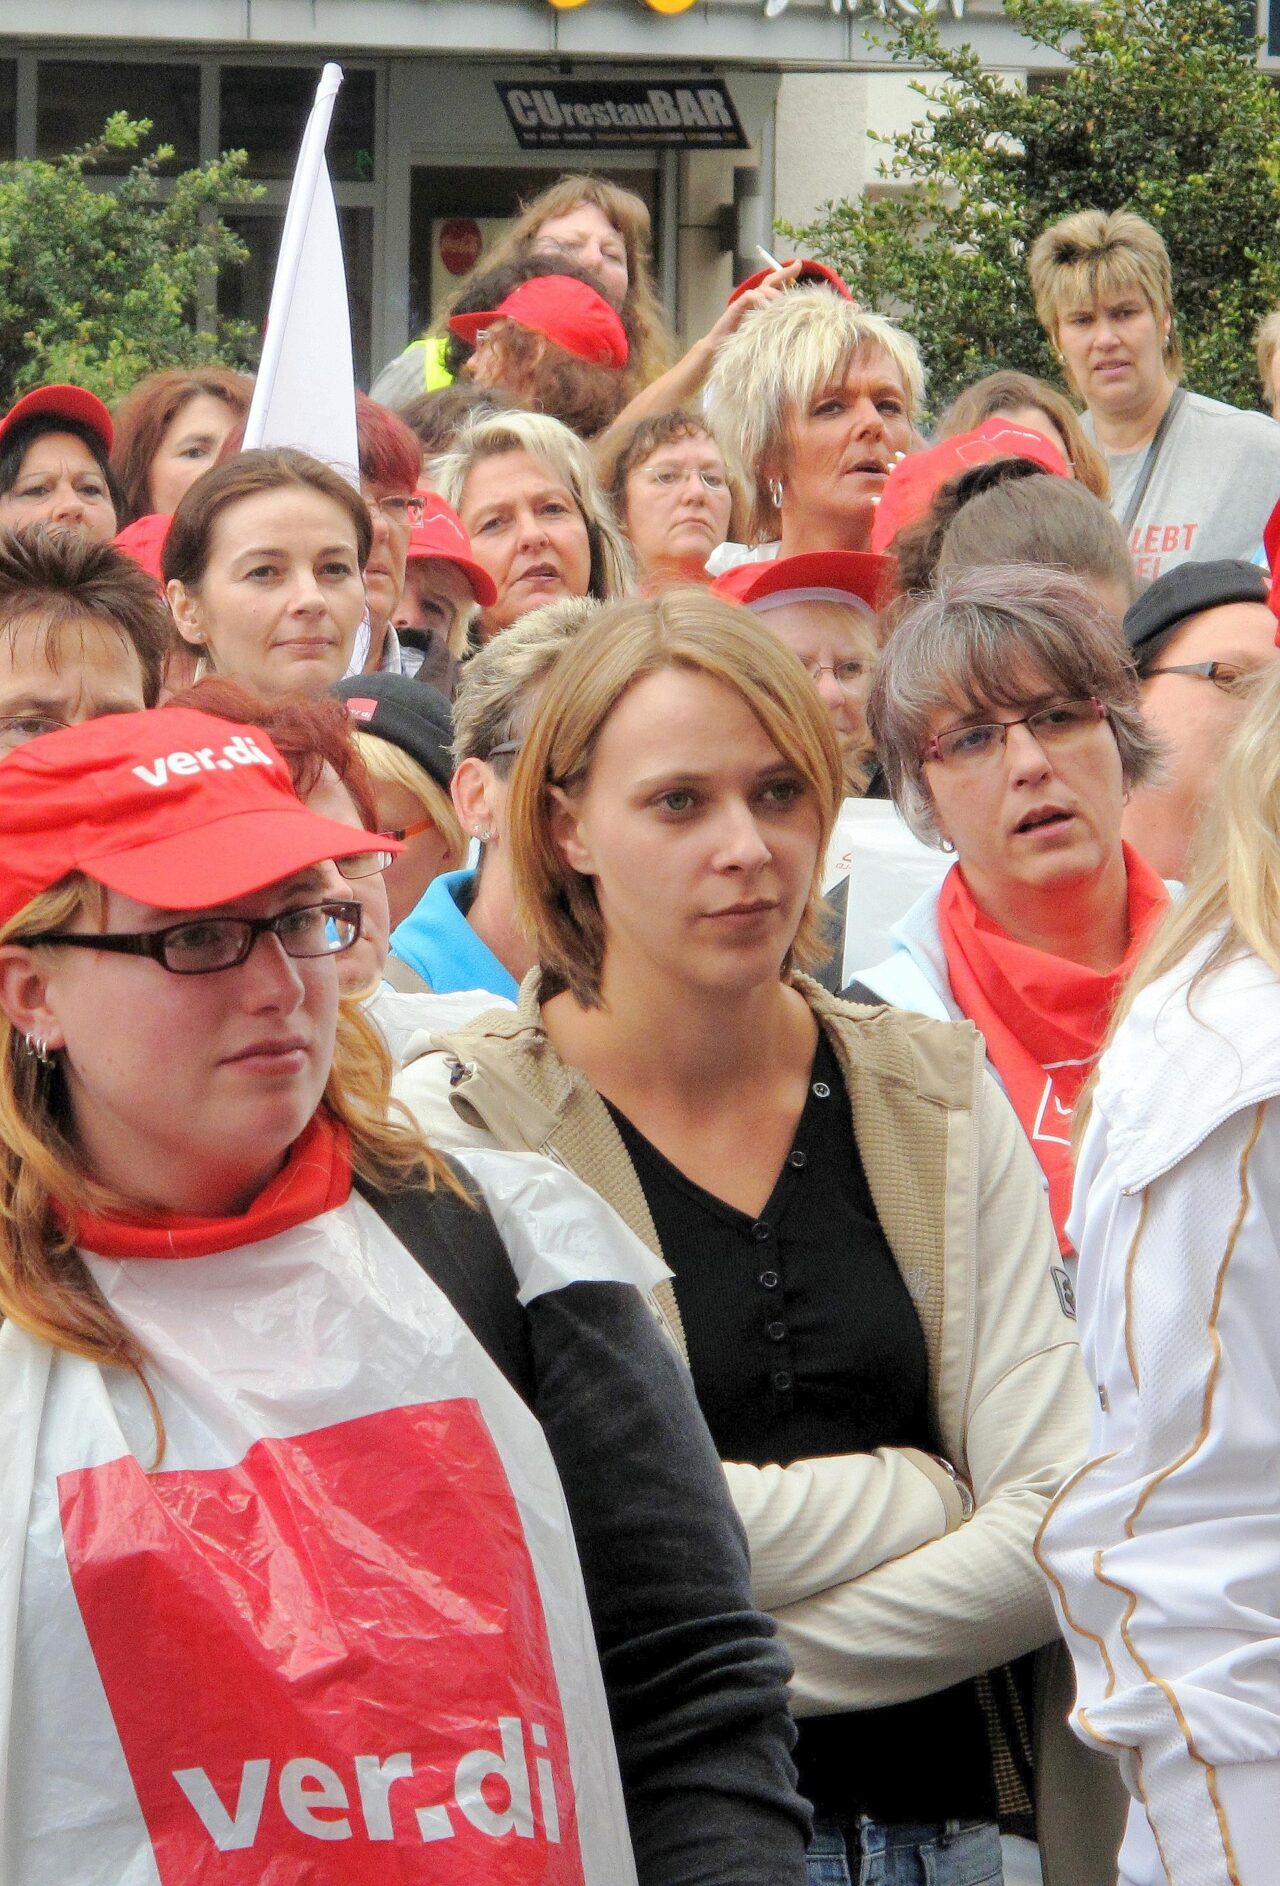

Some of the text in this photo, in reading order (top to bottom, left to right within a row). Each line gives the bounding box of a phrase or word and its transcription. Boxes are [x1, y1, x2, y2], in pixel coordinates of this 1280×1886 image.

[507, 89, 733, 126] CUrestauBAR
[132, 736, 273, 787] ver.di
[171, 1716, 562, 1852] ver.di
